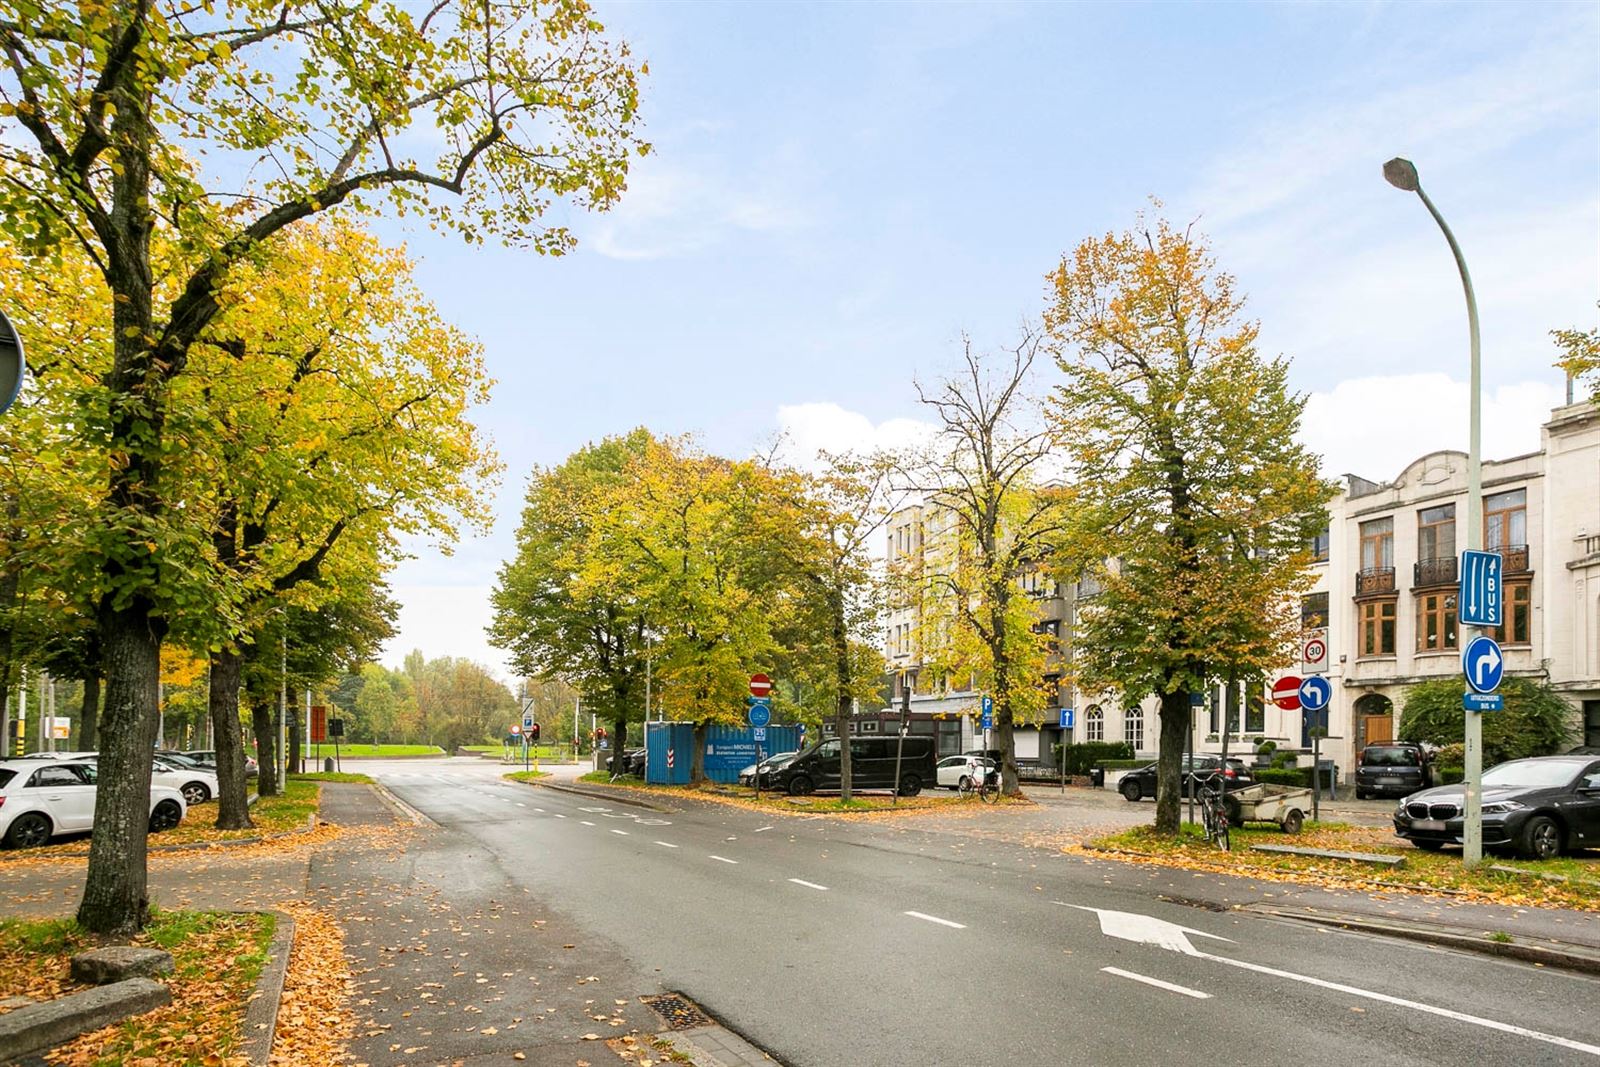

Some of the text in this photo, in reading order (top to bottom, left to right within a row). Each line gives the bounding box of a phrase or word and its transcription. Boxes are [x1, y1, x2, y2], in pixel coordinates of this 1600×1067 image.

[1487, 578, 1496, 621] BUS
[1309, 646, 1321, 656] 30
[984, 698, 991, 710] P
